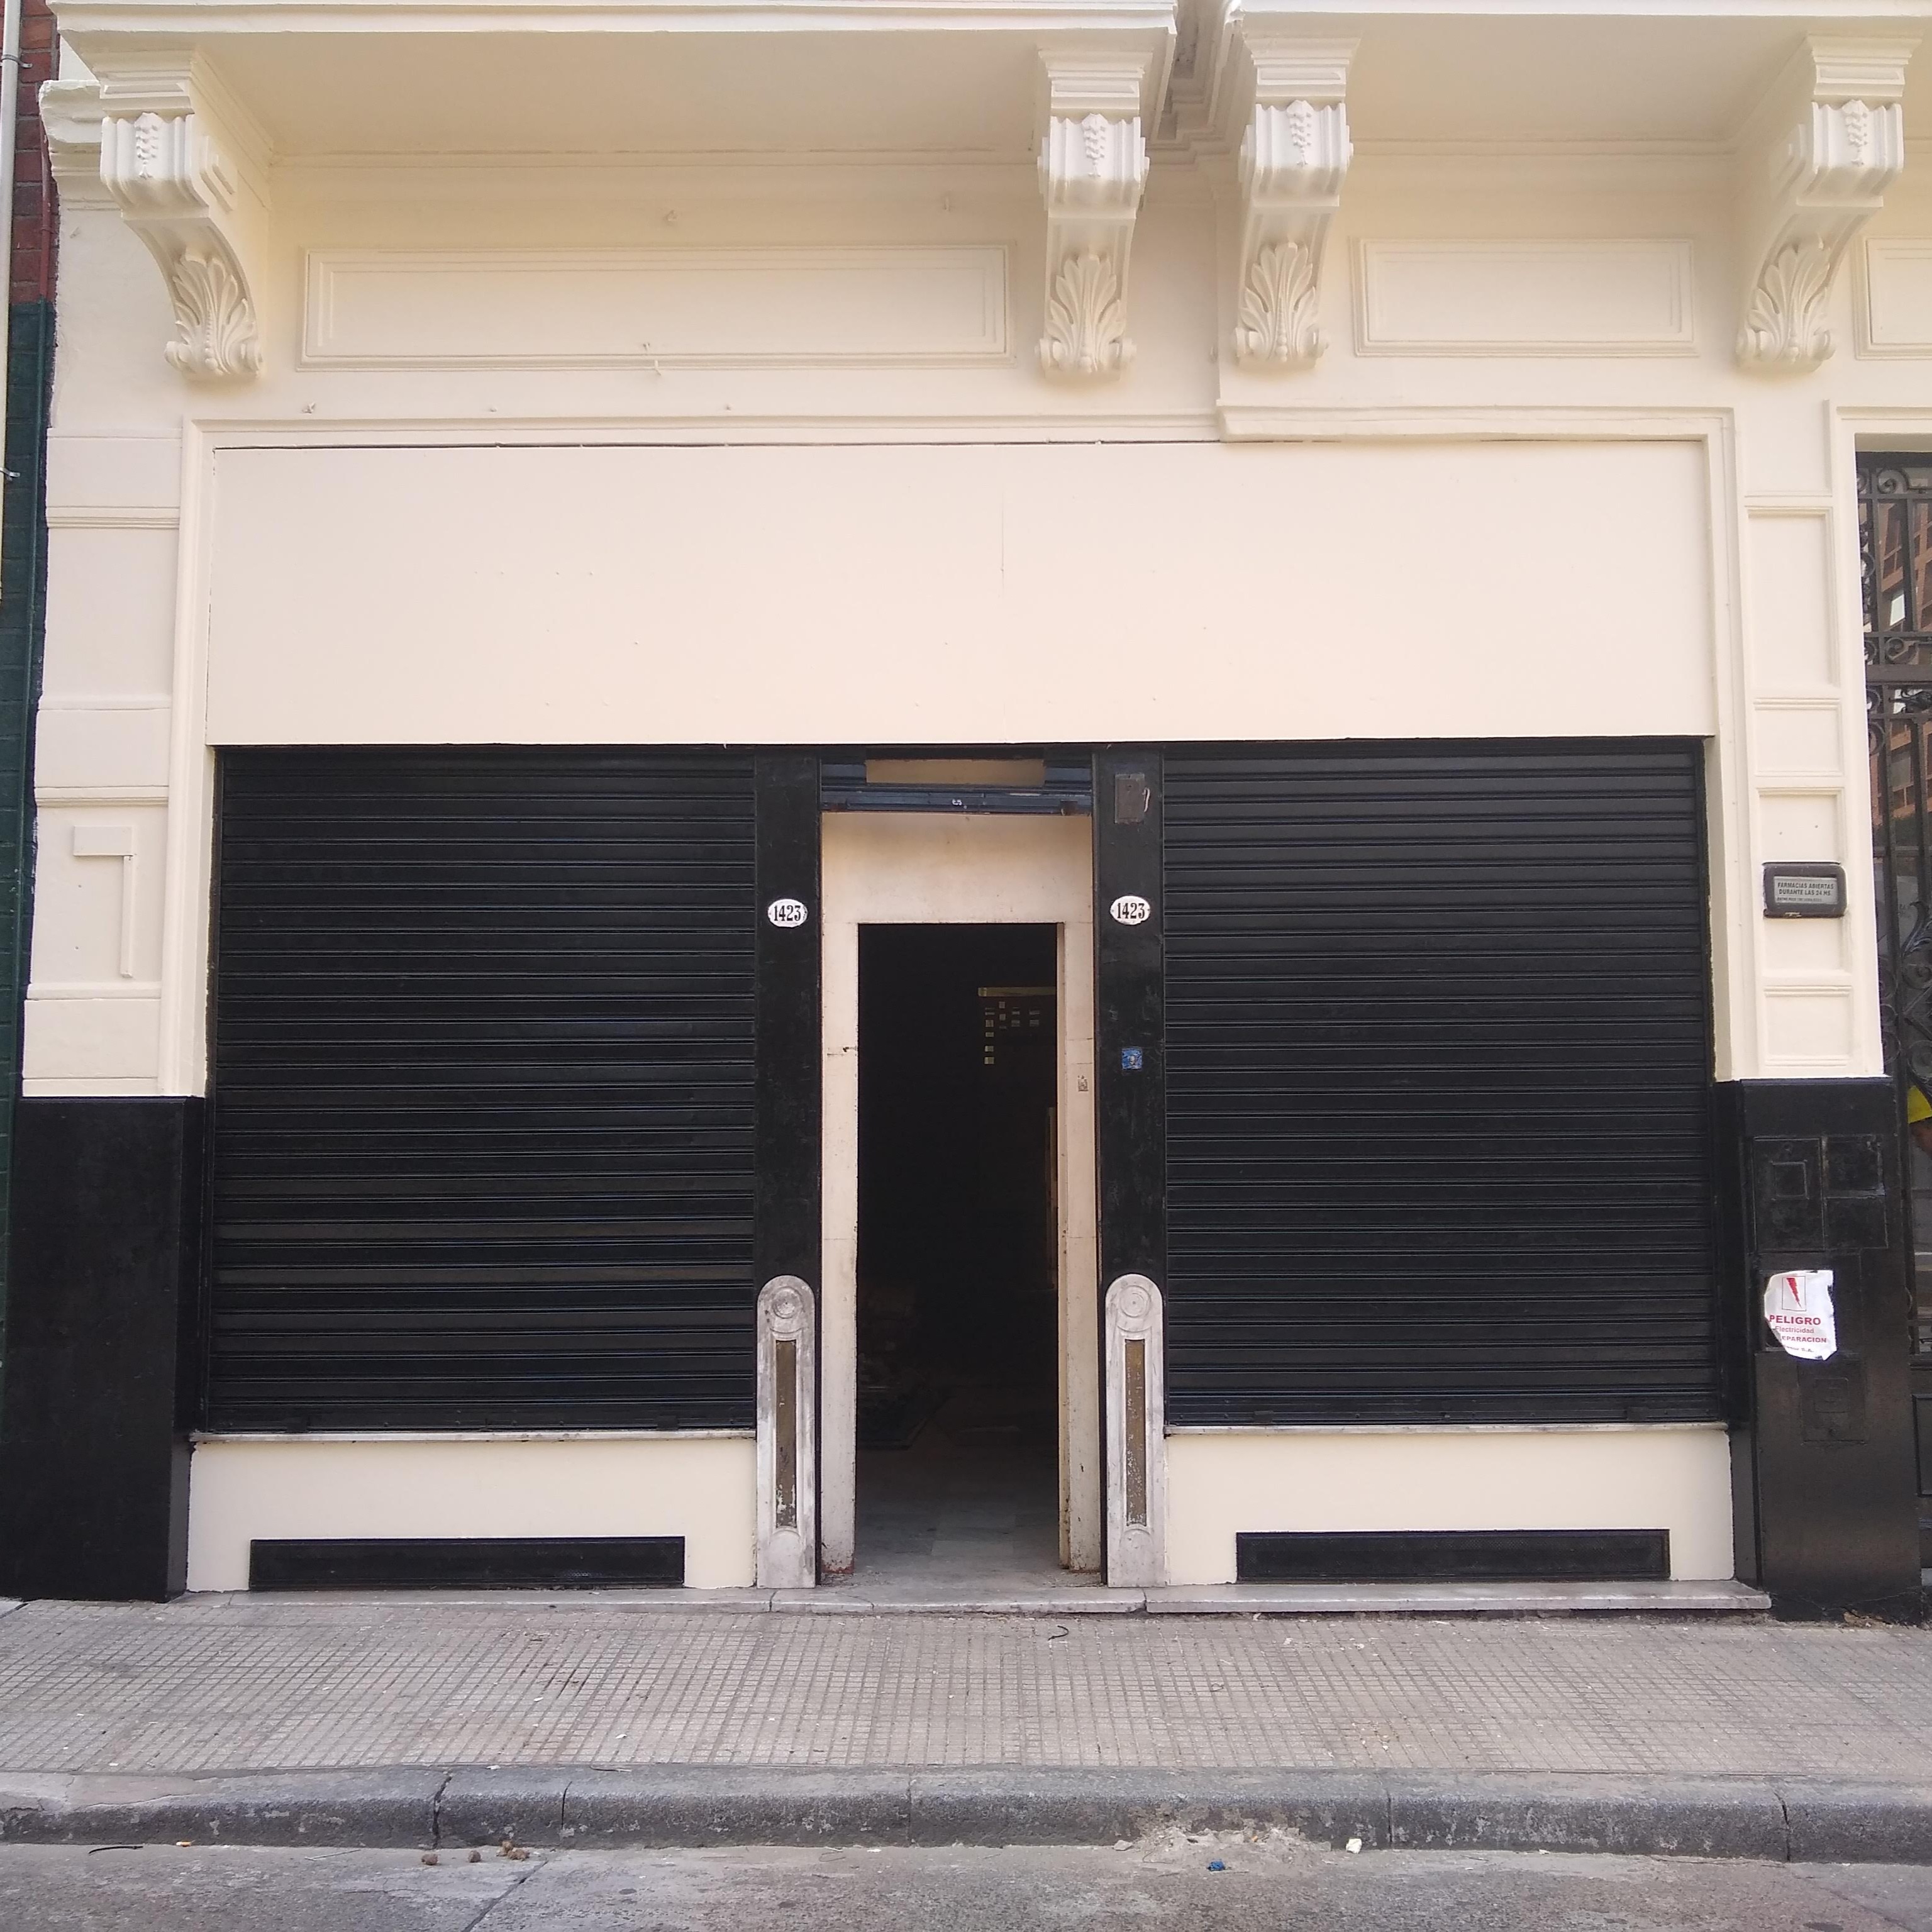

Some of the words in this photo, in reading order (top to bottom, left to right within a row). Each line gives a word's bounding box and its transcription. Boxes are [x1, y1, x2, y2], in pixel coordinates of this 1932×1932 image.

[774, 905, 801, 921] 1423
[1117, 902, 1145, 919] 1423
[1769, 1314, 1821, 1325] PELIGRO
[1781, 1335, 1827, 1343] EPARACION
